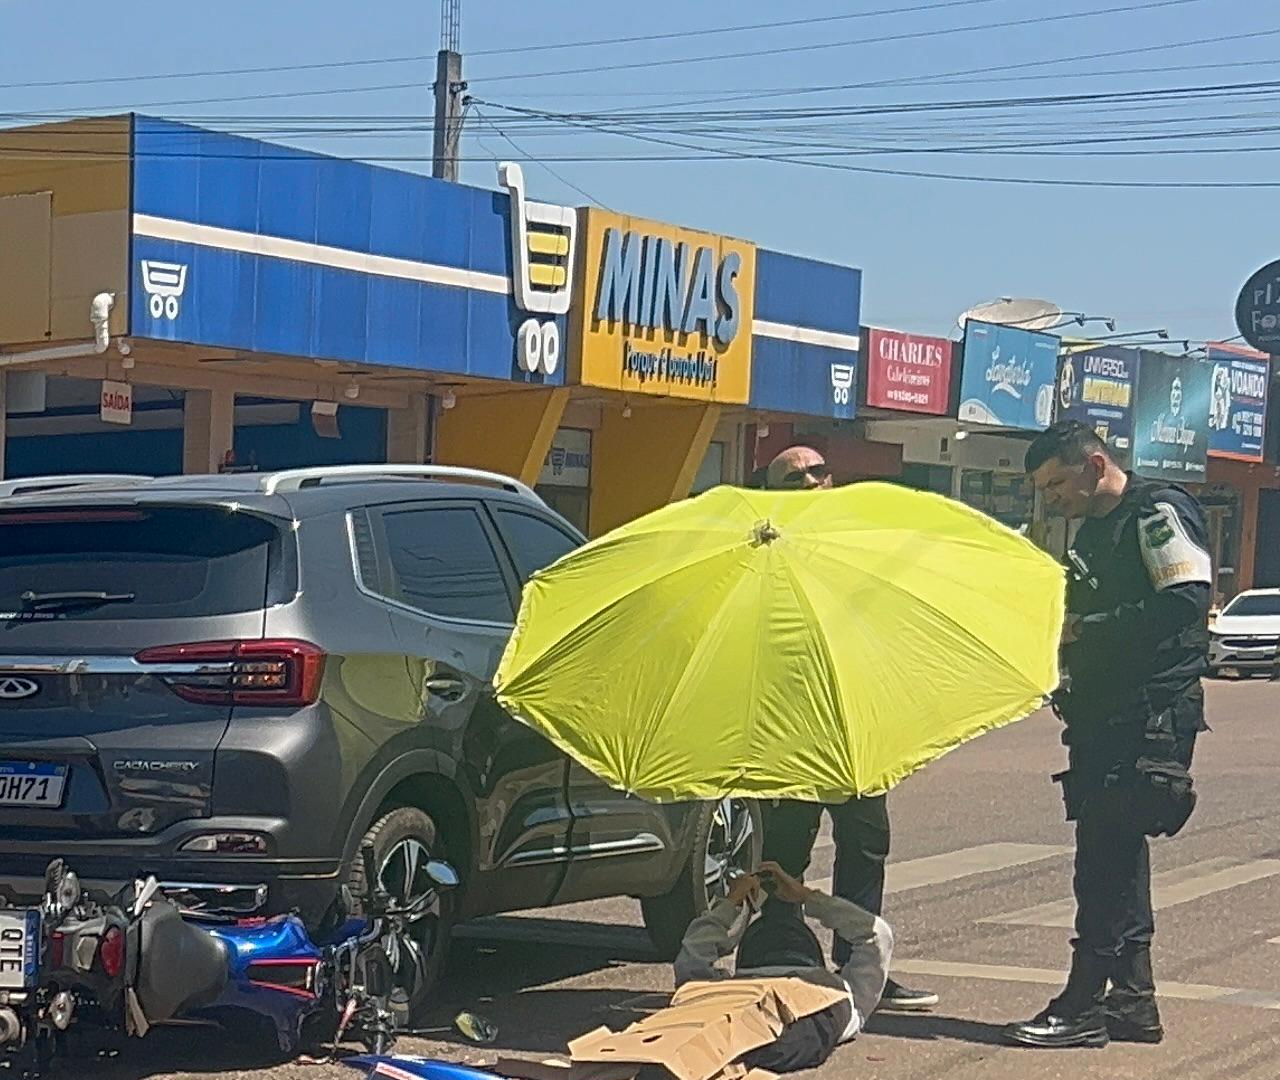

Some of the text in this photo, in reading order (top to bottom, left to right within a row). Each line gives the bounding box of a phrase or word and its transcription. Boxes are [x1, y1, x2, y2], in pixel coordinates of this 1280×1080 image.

[596, 227, 741, 346] MINAS
[879, 337, 943, 368] CHARLES
[103, 391, 129, 410] SAÍDA
[0, 928, 23, 972] QTE
